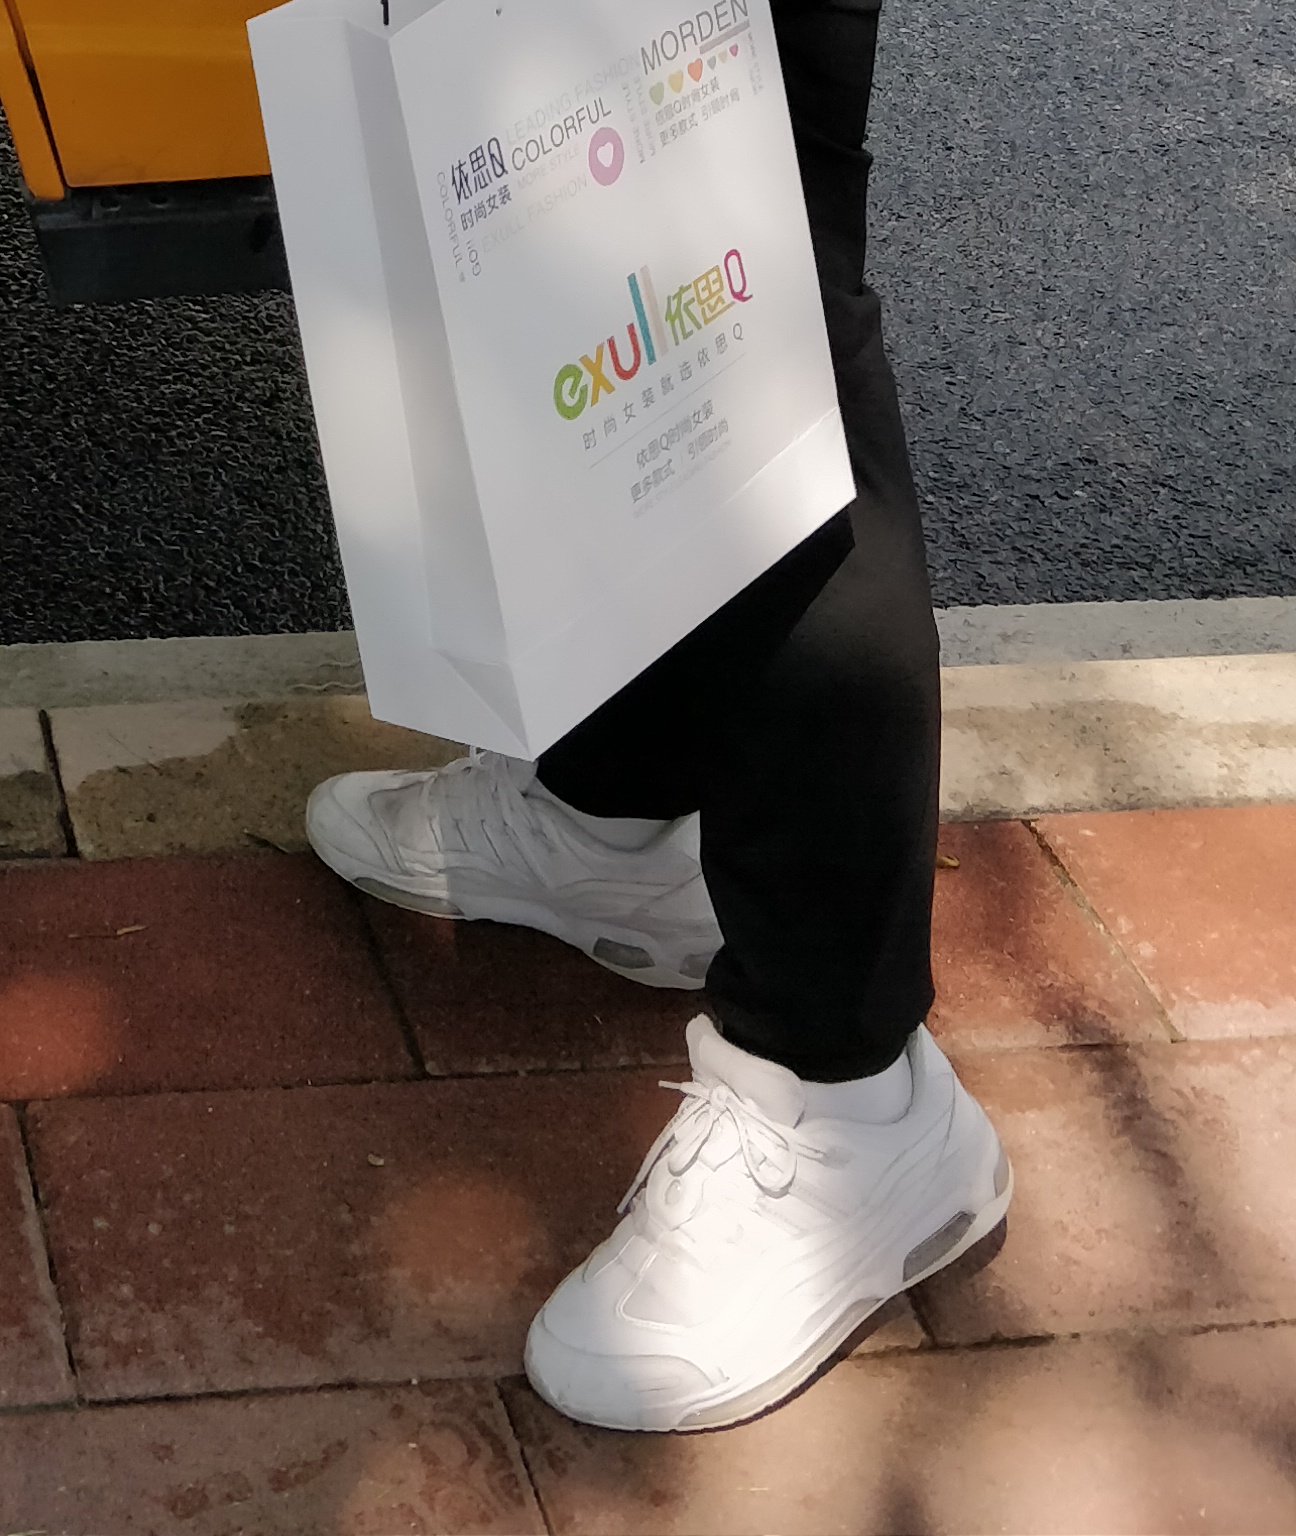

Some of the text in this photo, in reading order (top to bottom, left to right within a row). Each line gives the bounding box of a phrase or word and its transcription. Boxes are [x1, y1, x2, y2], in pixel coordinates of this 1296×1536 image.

[505, 54, 641, 145] LEADING FASHION
[451, 96, 612, 205] 依思Q COLORFUL
[436, 171, 464, 269] COLORFUL
[460, 184, 513, 232] 时尚女装
[482, 173, 589, 254] EXULL FASHION
[552, 248, 754, 422] exull 依思Q
